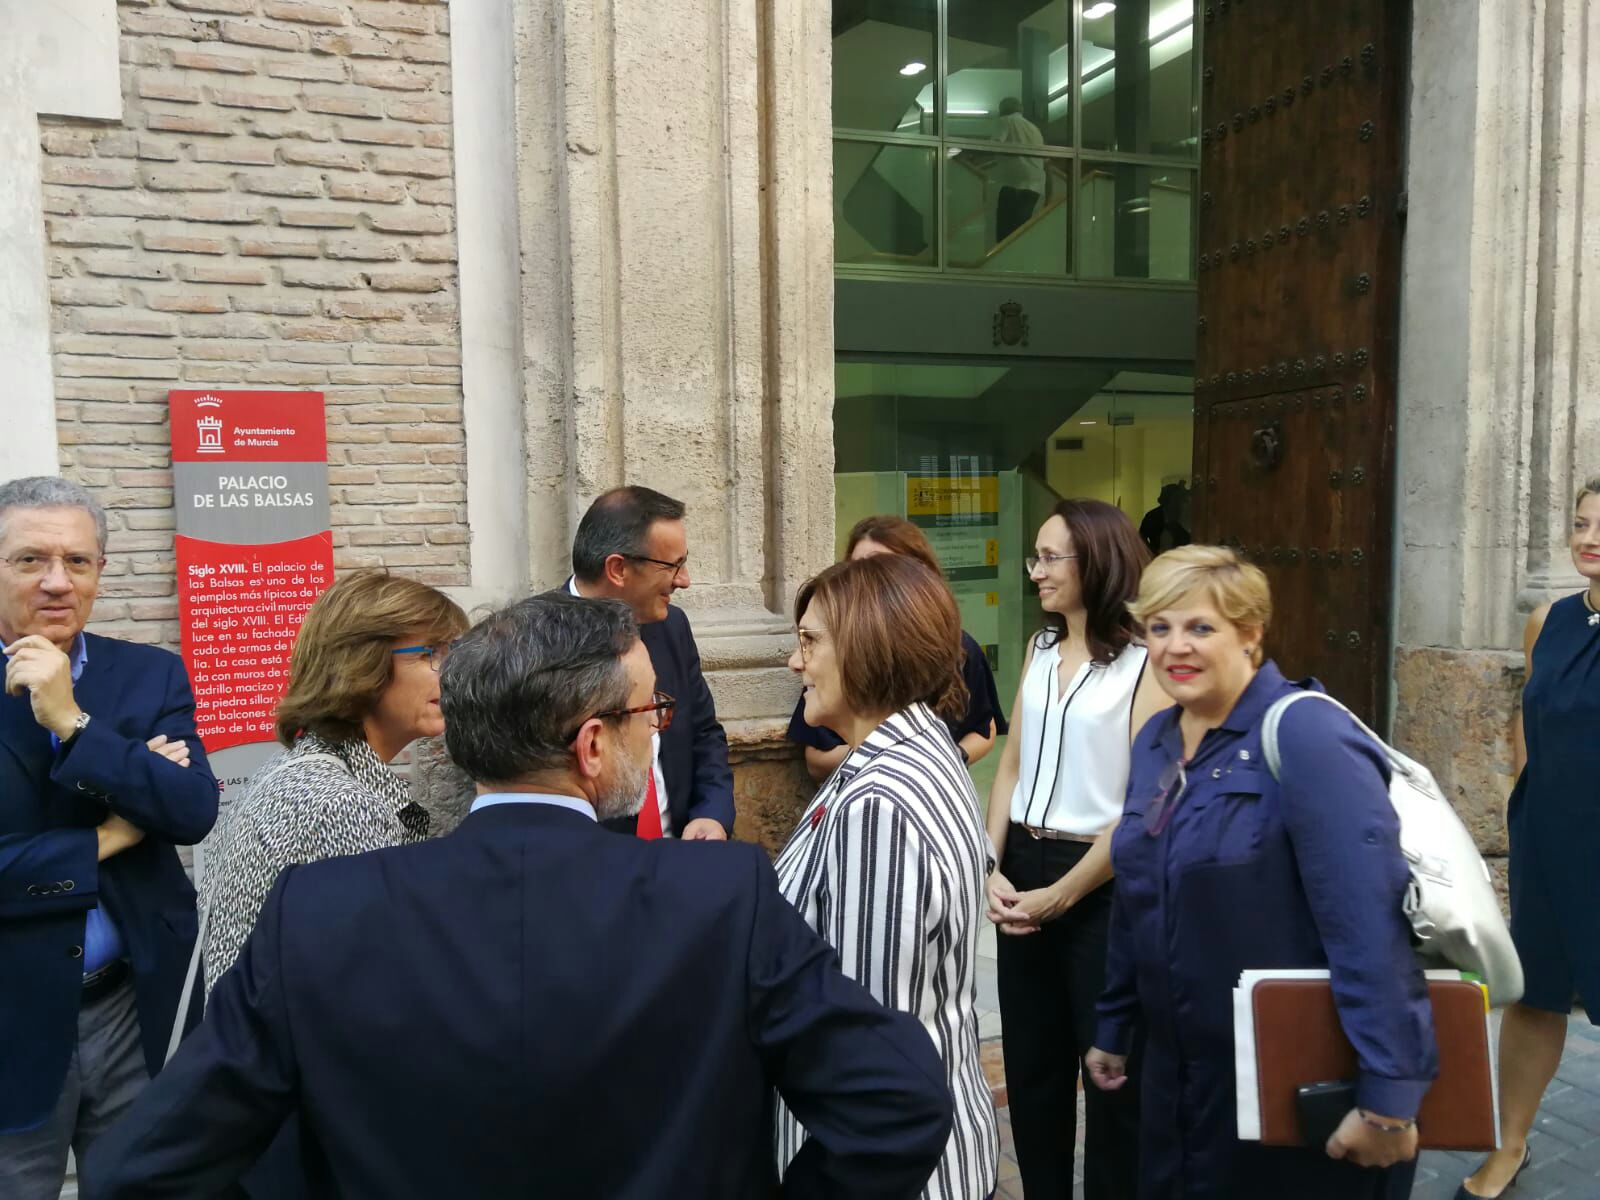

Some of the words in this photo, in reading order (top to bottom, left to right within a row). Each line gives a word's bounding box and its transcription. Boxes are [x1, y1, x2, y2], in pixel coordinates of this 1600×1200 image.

[234, 427, 295, 436] Ayuntamiento
[219, 476, 287, 489] PALACIO
[194, 494, 214, 507] DE
[220, 493, 249, 507] LAS
[254, 493, 313, 506] BALSAS
[188, 564, 215, 577] Siglo
[219, 563, 248, 574] XVIII.
[253, 561, 262, 573] El
[267, 561, 306, 574] palacio
[310, 560, 324, 571] de
[190, 577, 204, 588] las
[210, 577, 244, 588] Balsas
[291, 574, 305, 585] de
[310, 573, 324, 583] los
[190, 590, 237, 605] ejemplos
[240, 590, 261, 600] más
[264, 589, 297, 601] típicos
[300, 587, 312, 598] de
[191, 604, 254, 618] arquitectura
[256, 601, 276, 613] civil
[278, 602, 313, 611] murcia
[192, 617, 208, 629] del
[213, 616, 238, 630] siglo
[243, 614, 269, 626] XVIII.
[275, 614, 283, 625] El
[288, 613, 305, 624] Edi
[192, 632, 214, 643] luce
[252, 627, 295, 639] fachada
[193, 644, 220, 656] cudo
[222, 643, 236, 654] de
[239, 644, 271, 653] armas
[274, 640, 287, 651] de
[194, 659, 211, 669] lia.
[216, 658, 228, 668] La
[231, 658, 257, 666] casa
[261, 655, 282, 665] está
[194, 672, 209, 683] da
[211, 673, 231, 681] con
[234, 670, 265, 679] muros
[267, 667, 281, 678] de
[195, 683, 233, 696] ladrillo
[235, 682, 274, 692] macizo
[277, 683, 283, 692] y
[196, 698, 210, 709] de
[212, 696, 247, 711] piedra
[249, 694, 277, 705] sillar,
[196, 713, 216, 722] con
[219, 709, 266, 721] balcones
[196, 724, 226, 738] gusto
[229, 722, 243, 733] de
[246, 721, 257, 731] la
[227, 778, 242, 786] LAS
